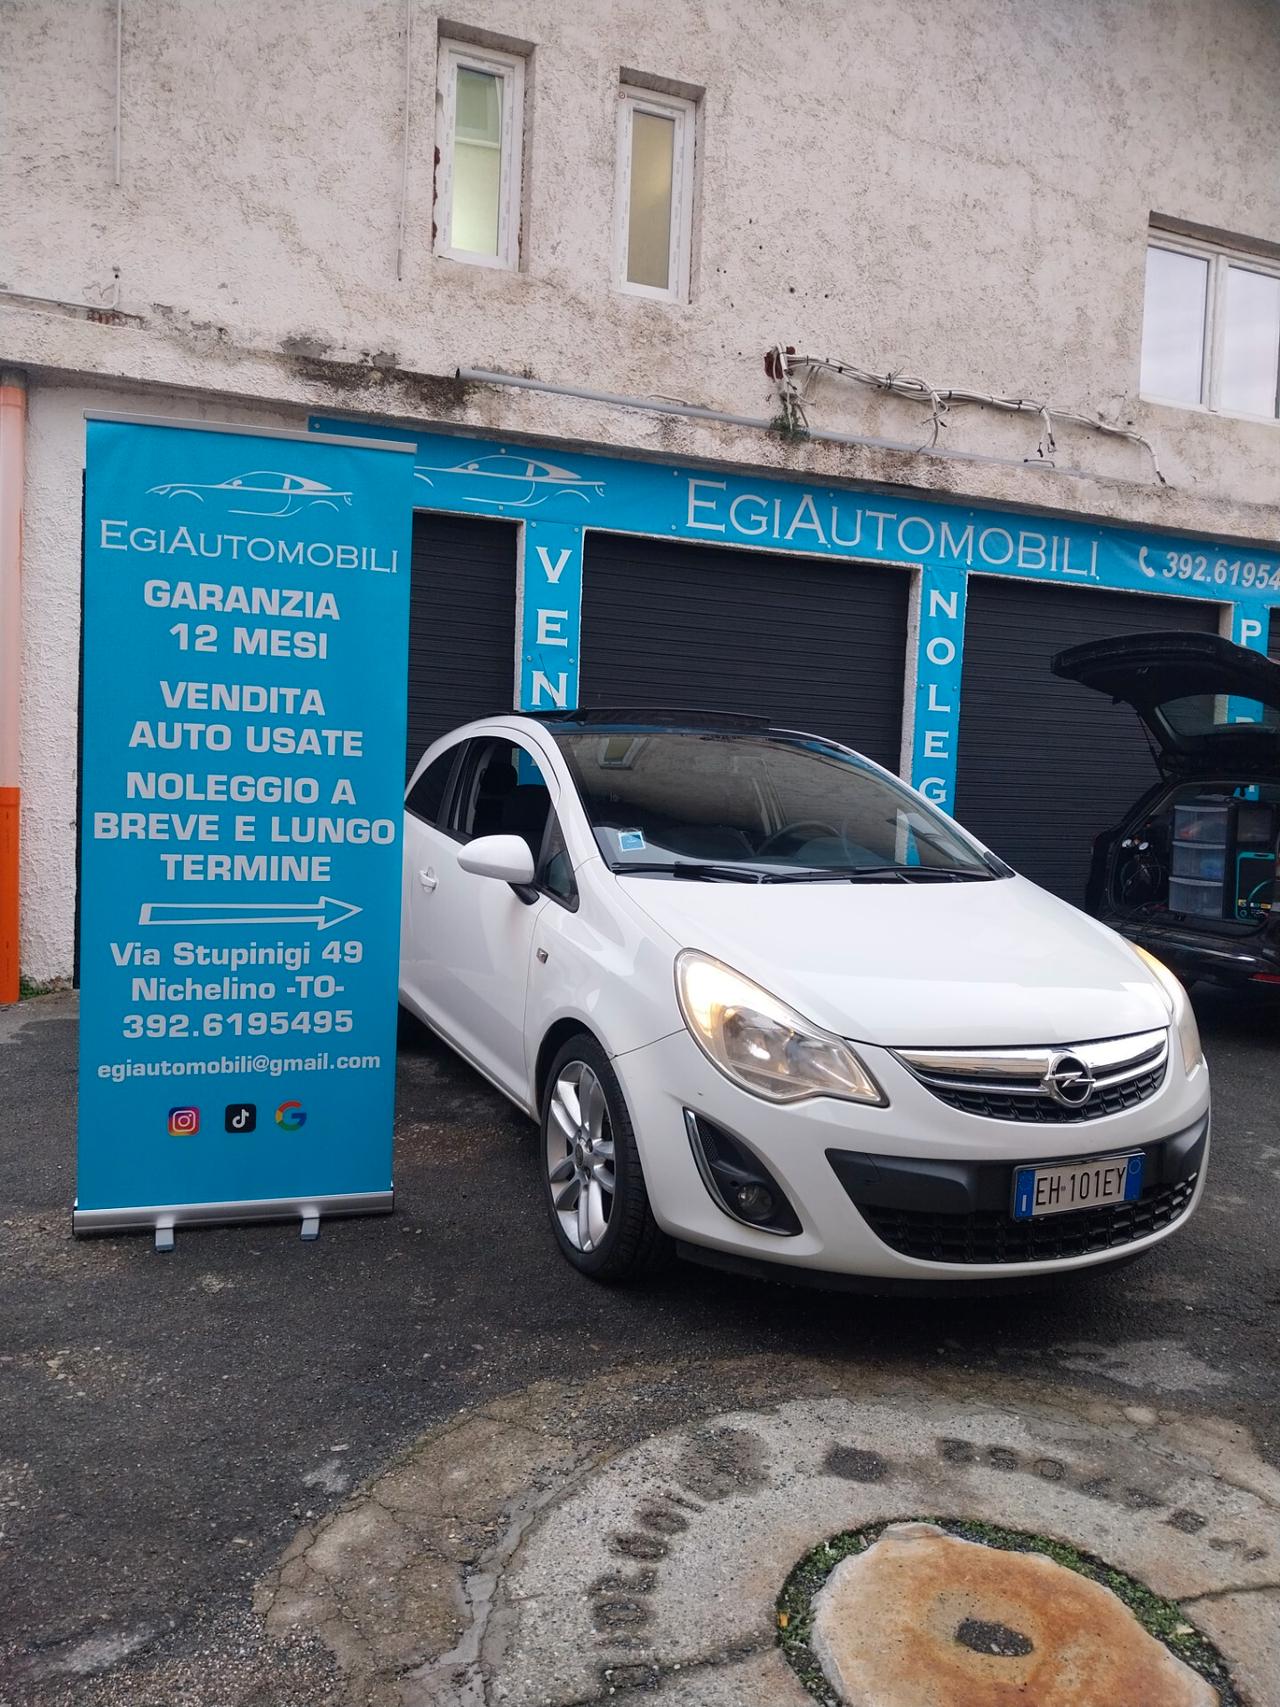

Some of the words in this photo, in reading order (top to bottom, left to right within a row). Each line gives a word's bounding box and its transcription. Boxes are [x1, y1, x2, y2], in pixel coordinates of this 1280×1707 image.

[144, 579, 340, 620] GARANZIA
[169, 623, 218, 652] 12
[233, 627, 328, 659] MESI
[160, 680, 326, 716] VENDITA
[128, 720, 232, 751] AUTO
[246, 726, 363, 757] USATE
[126, 771, 319, 803] NOLEGGIO
[331, 779, 357, 805] A
[94, 812, 219, 841] BREVE
[235, 815, 256, 842] E
[271, 816, 395, 844] LUNGO
[160, 853, 331, 882] TERMINE
[110, 942, 161, 966] Via
[173, 941, 310, 972] Stupinigi
[321, 940, 363, 963] 49
[131, 977, 276, 1001] Nichelino
[122, 1010, 353, 1039] 392.6195495
[97, 1053, 380, 1083] egiautomobili@gmail.com
